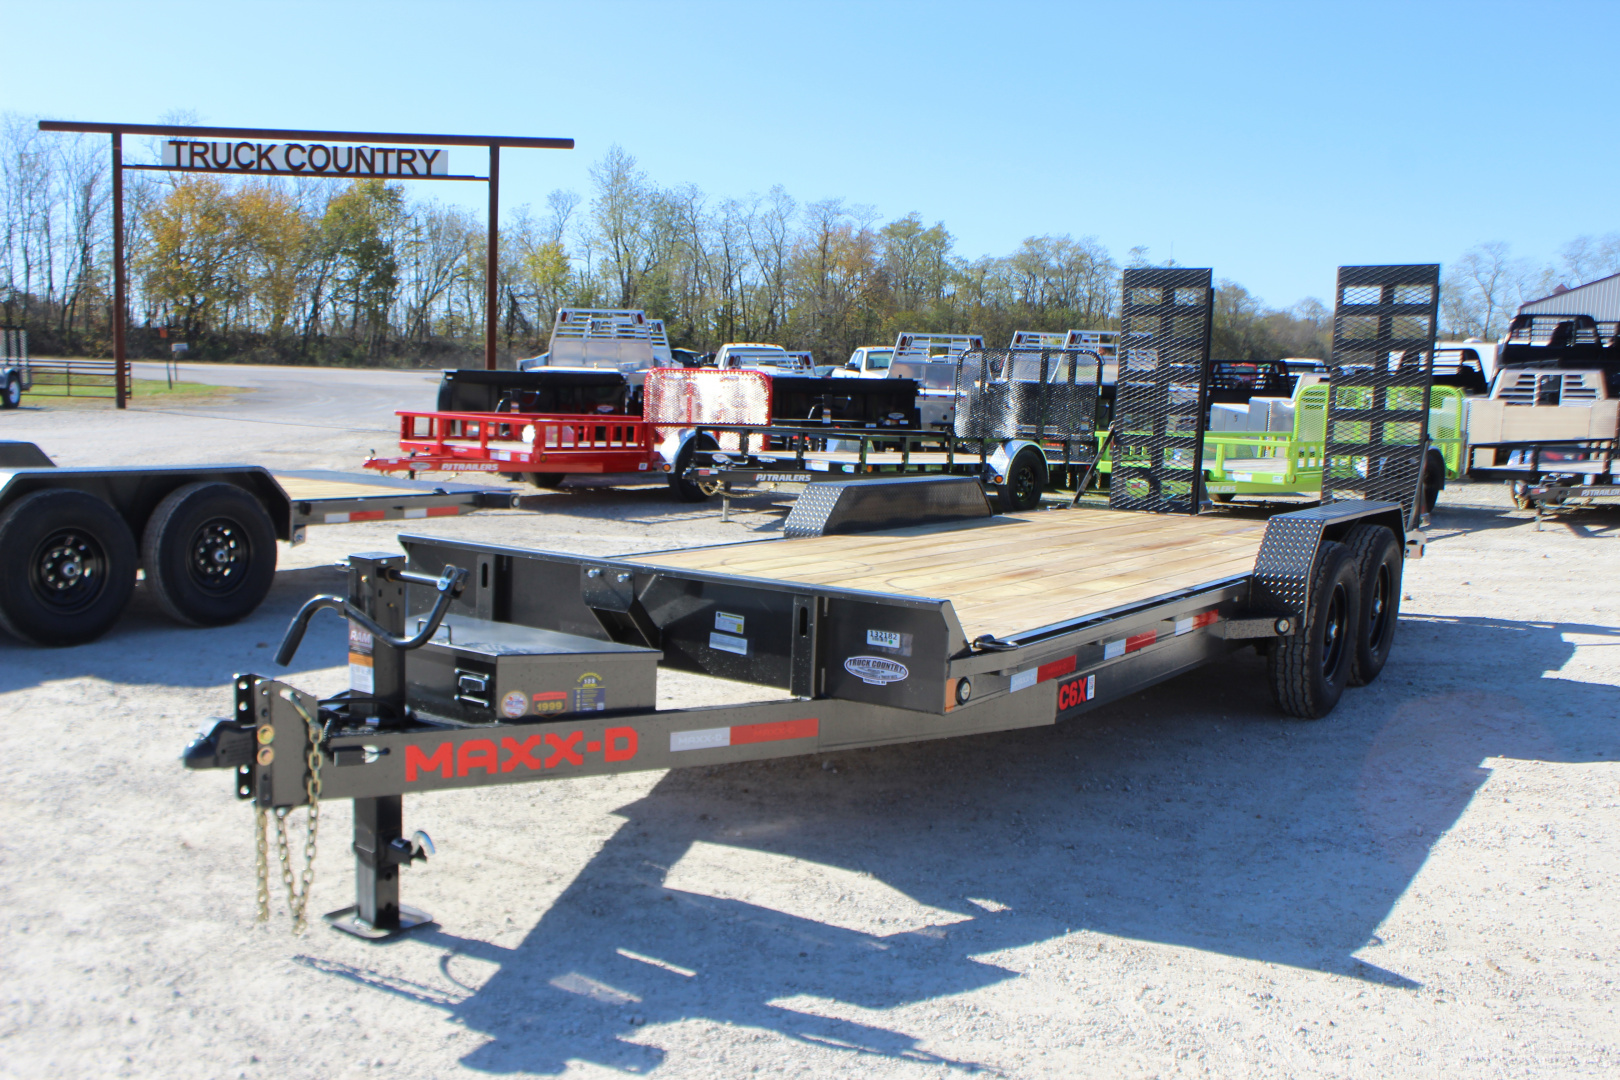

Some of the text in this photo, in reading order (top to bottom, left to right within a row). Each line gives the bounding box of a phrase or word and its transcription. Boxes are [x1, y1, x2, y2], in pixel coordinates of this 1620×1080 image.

[168, 140, 441, 176] TRUCK COUNTRY
[350, 629, 371, 644] RAM
[870, 630, 898, 641] 132182
[849, 659, 871, 668] TRUCK
[871, 660, 904, 673] COUNTRY
[1058, 677, 1088, 711] C6X
[536, 701, 563, 712] 1999
[405, 726, 638, 783] MAXX-D
